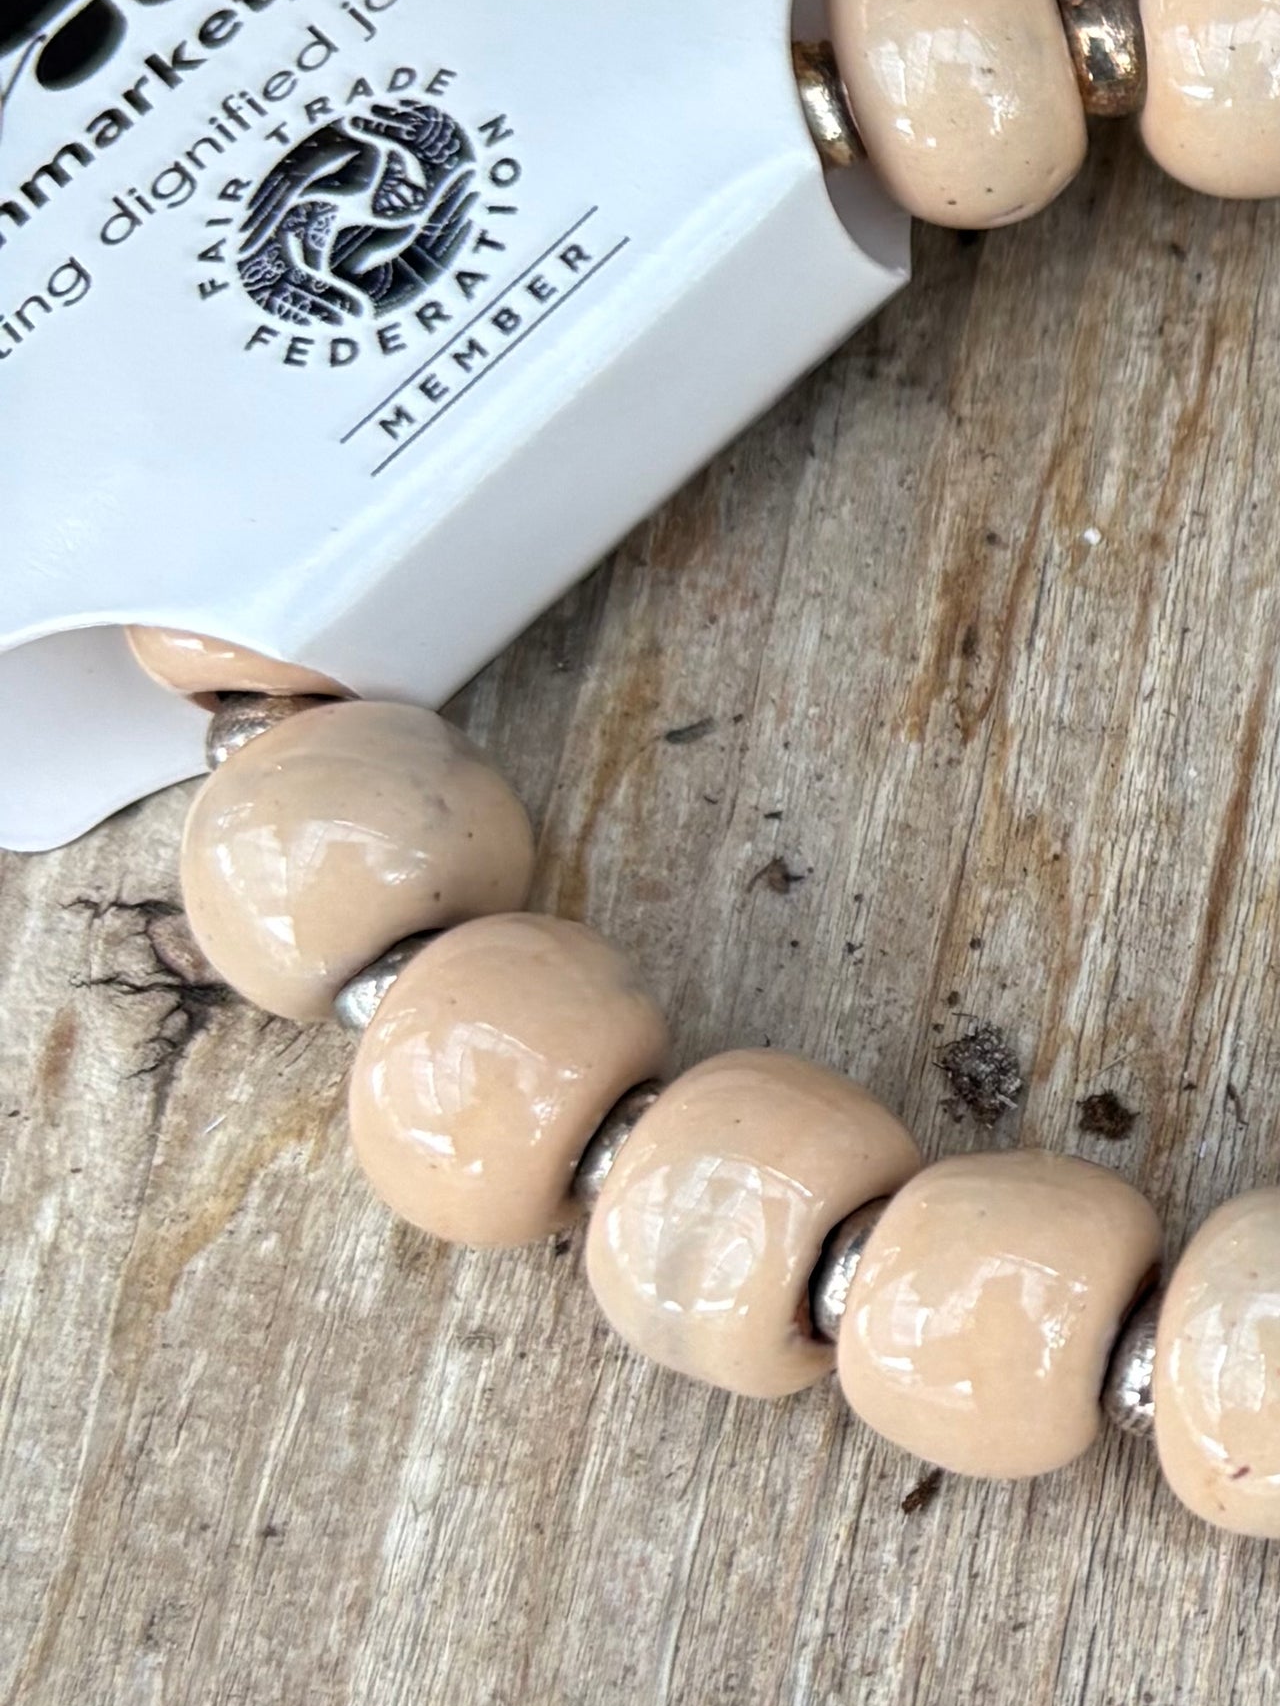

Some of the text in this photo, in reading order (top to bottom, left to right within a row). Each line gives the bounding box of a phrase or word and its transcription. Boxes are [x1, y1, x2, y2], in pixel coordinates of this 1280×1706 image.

[0, 255, 94, 361] ing
[99, 24, 340, 247] dignified
[197, 67, 458, 301] FAIR TRADE
[243, 112, 523, 369] FEDERATION
[377, 242, 594, 440] MEMBER
